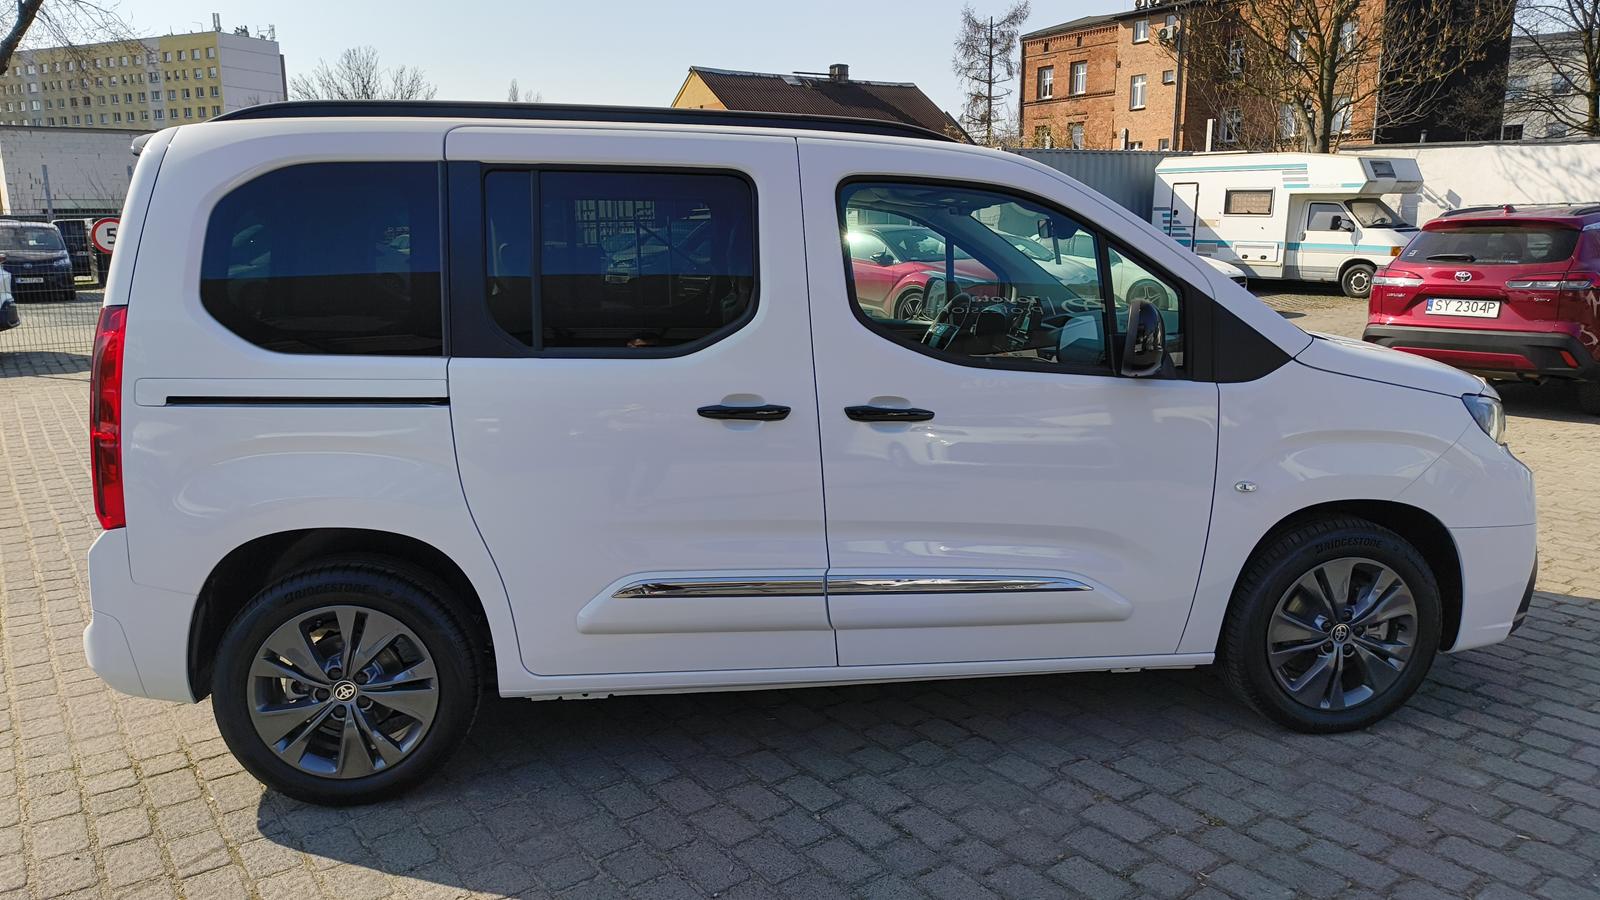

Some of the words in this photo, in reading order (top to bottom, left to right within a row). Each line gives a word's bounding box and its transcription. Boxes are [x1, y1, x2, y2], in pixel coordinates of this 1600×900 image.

[1435, 299, 1452, 311] SY
[1455, 300, 1496, 314] 2304P
[1315, 535, 1384, 554] BRIDGESTONE
